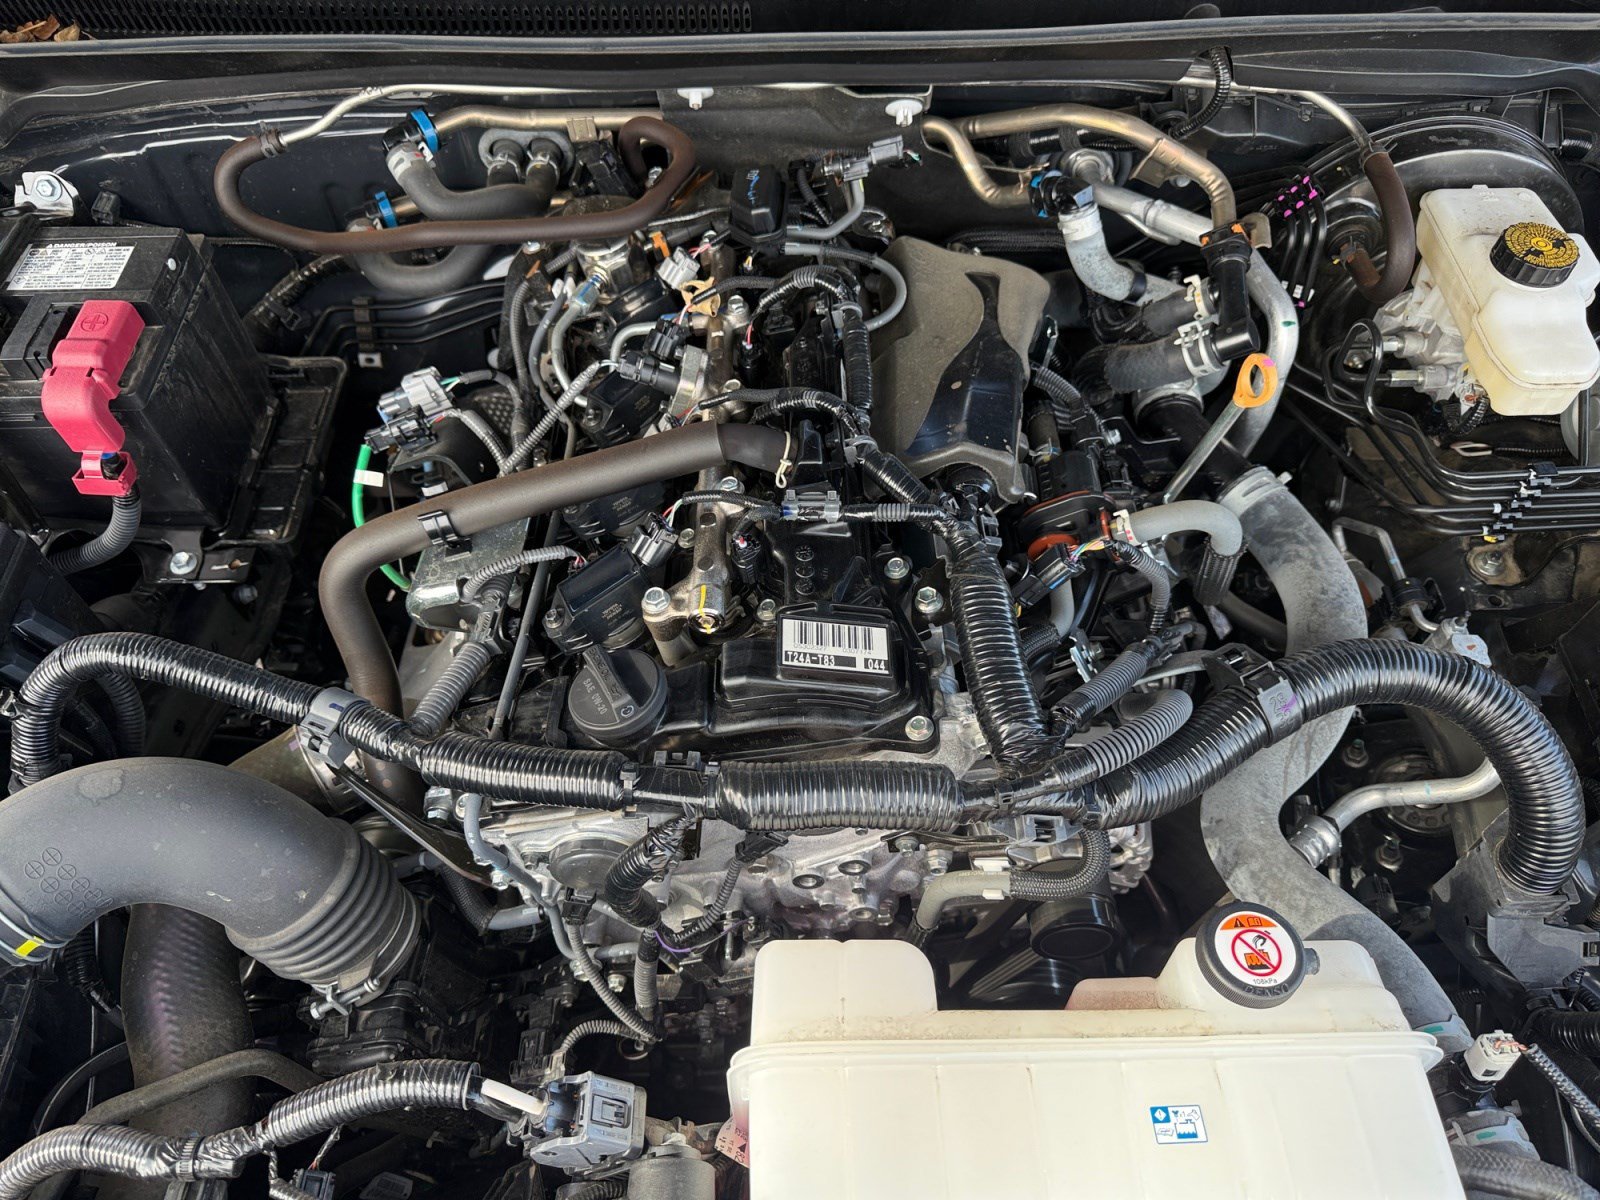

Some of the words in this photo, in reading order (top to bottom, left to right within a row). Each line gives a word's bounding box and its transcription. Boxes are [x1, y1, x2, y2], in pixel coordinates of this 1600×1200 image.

[786, 651, 836, 667] T24A-T83
[867, 659, 886, 671] 044
[583, 678, 596, 693] SAE
[1245, 983, 1289, 996] DENSO
